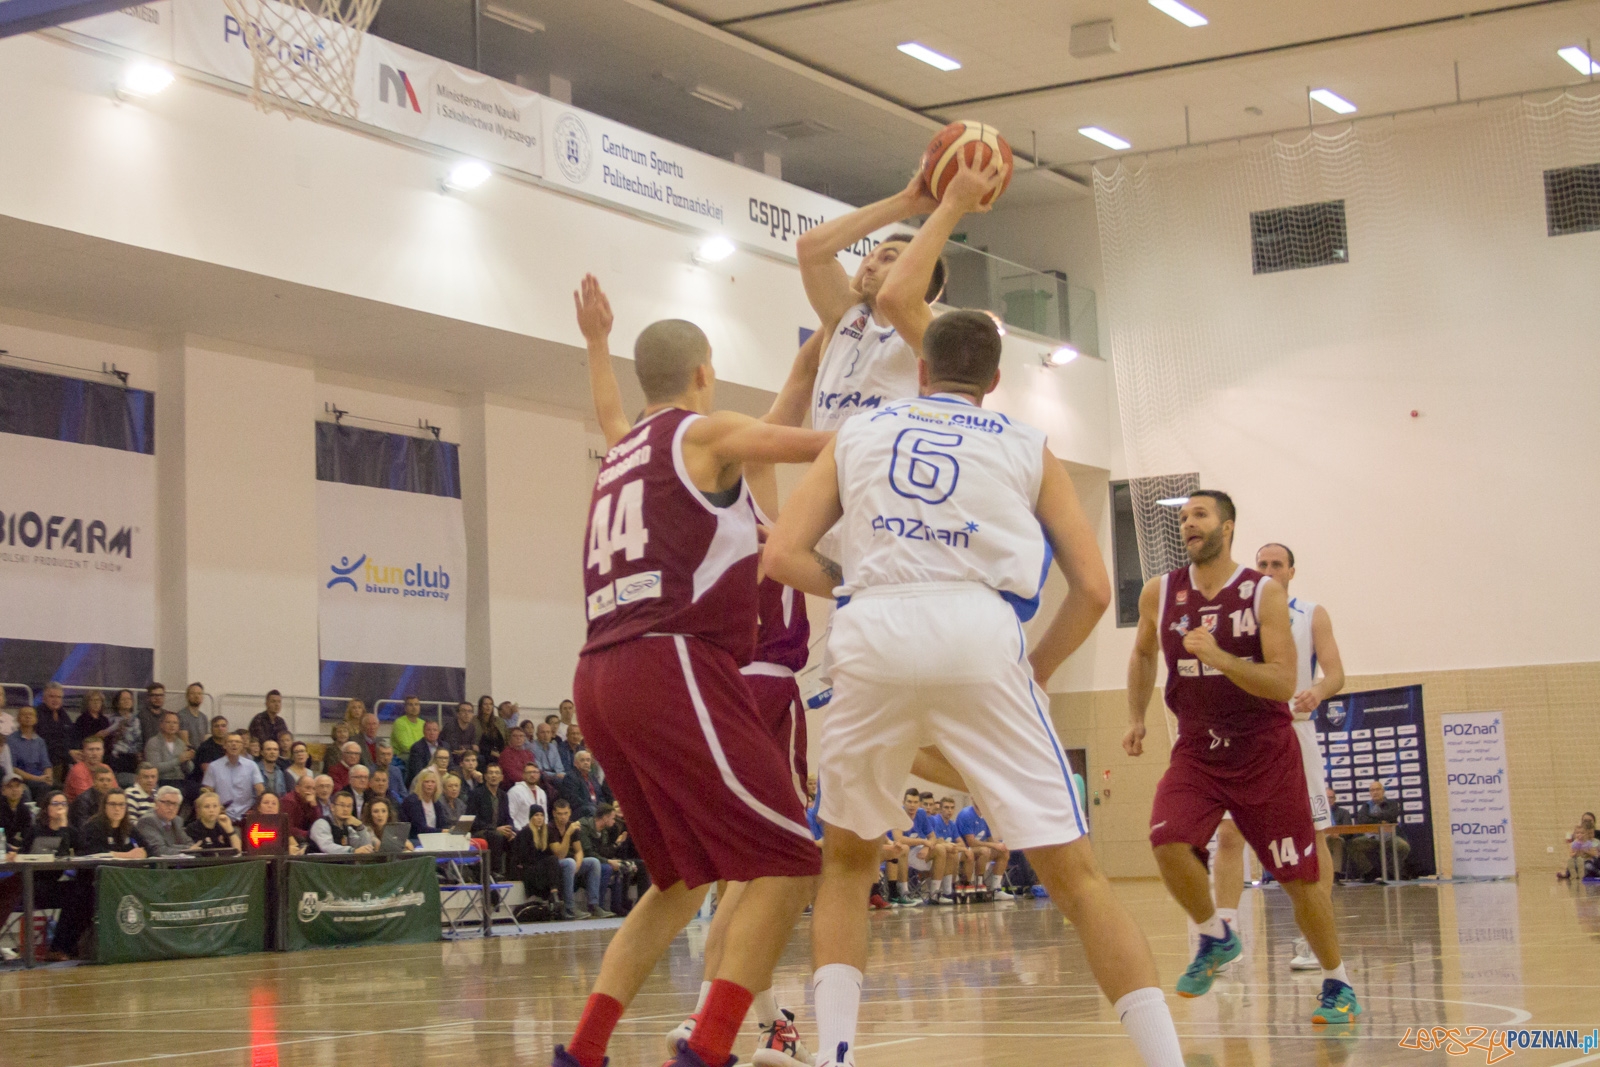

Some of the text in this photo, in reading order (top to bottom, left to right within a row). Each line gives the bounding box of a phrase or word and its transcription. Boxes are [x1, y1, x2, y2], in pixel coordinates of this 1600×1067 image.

[436, 84, 520, 122] Ministerstwo Nauki
[443, 106, 494, 133] Szkolnictwa
[495, 121, 537, 147] Wyższego
[602, 134, 683, 178] Centrum Sportu
[603, 165, 723, 225] Politechniki Poznańskiej
[888, 427, 963, 505] 6
[587, 478, 649, 575] 44
[365, 557, 450, 590] funclub
[365, 583, 450, 601] biuro podróży
[1228, 607, 1257, 637] 14
[1268, 836, 1299, 869] 14
